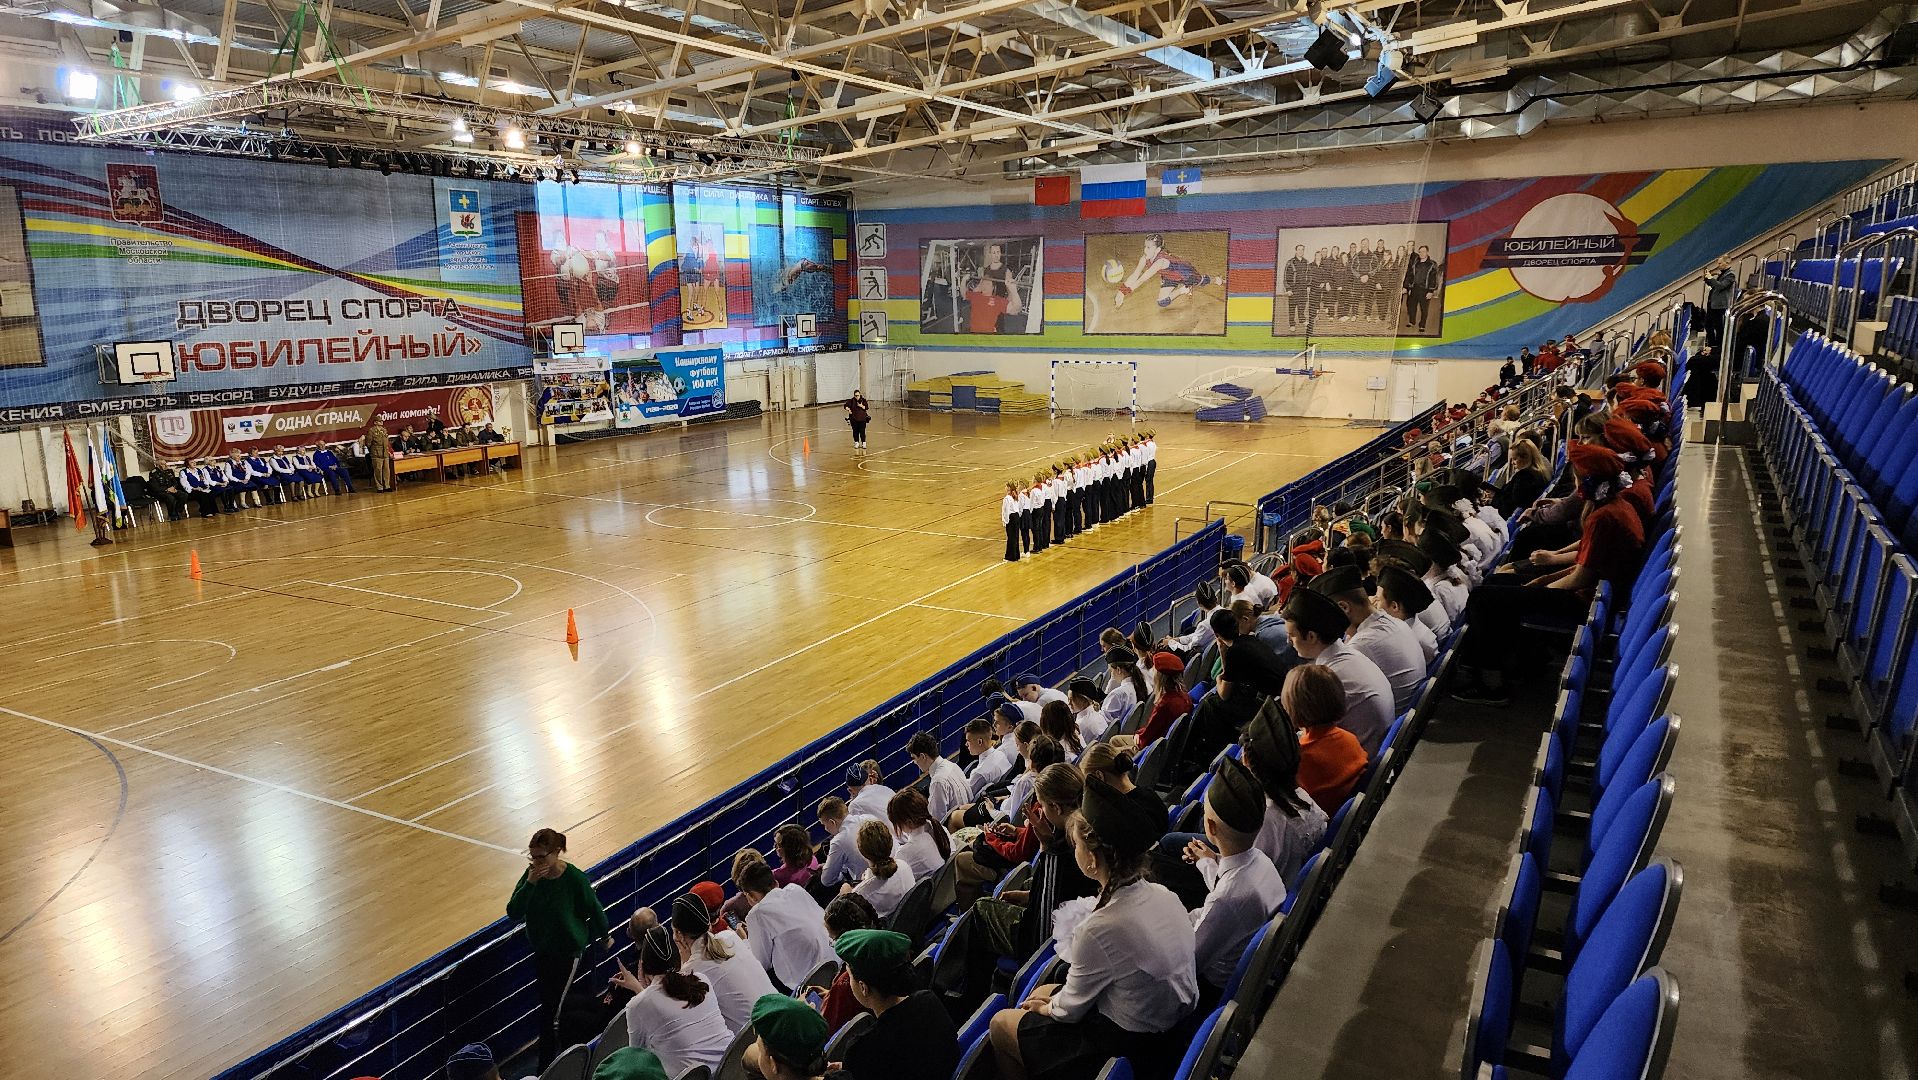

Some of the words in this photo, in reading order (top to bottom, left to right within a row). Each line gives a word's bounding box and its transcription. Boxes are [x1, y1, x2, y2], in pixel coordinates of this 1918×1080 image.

[0, 126, 24, 139] ТЬ
[703, 189, 725, 199] СИЛА
[800, 197, 820, 206] СТАРТ
[110, 238, 173, 247] Правительство
[1504, 236, 1615, 251] ЮБИЛЕЙНЫЙ
[119, 247, 168, 255] Московской
[128, 256, 162, 264] области
[1522, 258, 1560, 267] ДВОРЕЦ
[1561, 258, 1597, 266] СПОРТА
[177, 299, 331, 330] ДВОРЕЦ
[341, 297, 464, 320] СПОРТА
[175, 326, 482, 373] ЮБИЛЕЙНЫЙ»
[674, 356, 718, 367] Каширскому
[692, 379, 704, 389] 100
[78, 396, 177, 415] СМЕЛОСТЬ
[189, 390, 254, 404] РЕКОРД
[269, 383, 341, 398] БУДУЩЕЕ
[354, 378, 396, 390] СПОРТ
[404, 375, 438, 386] СИЛА
[446, 369, 511, 384] ДИНАМИКА
[377, 411, 398, 421] одна
[400, 405, 440, 419] команда!
[275, 415, 313, 432] ОДНА
[314, 410, 363, 429] СТРАНА,
